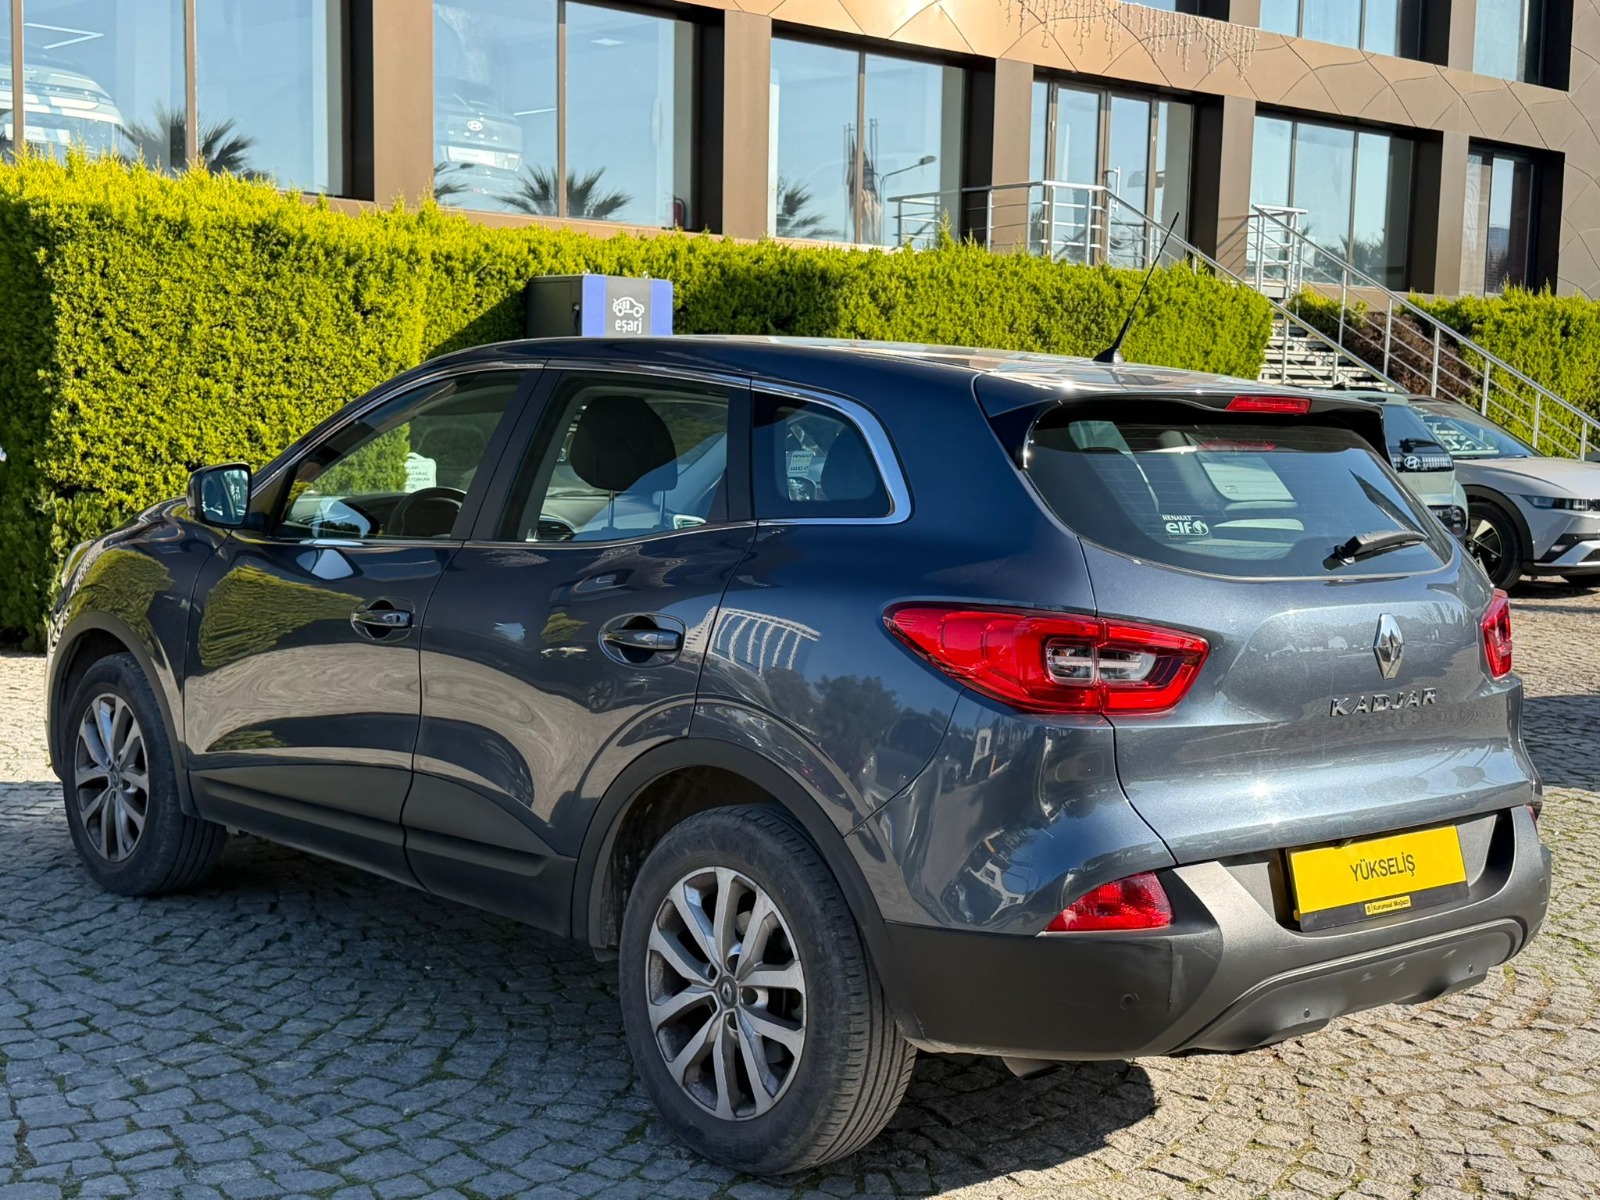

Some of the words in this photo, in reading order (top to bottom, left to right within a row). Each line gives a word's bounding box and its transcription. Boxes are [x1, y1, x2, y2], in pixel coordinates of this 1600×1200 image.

[615, 317, 642, 335] eşarj
[1165, 521, 1192, 534] elf
[1330, 687, 1437, 717] KADJAR
[1349, 852, 1416, 882] YÜKSELİŞ
